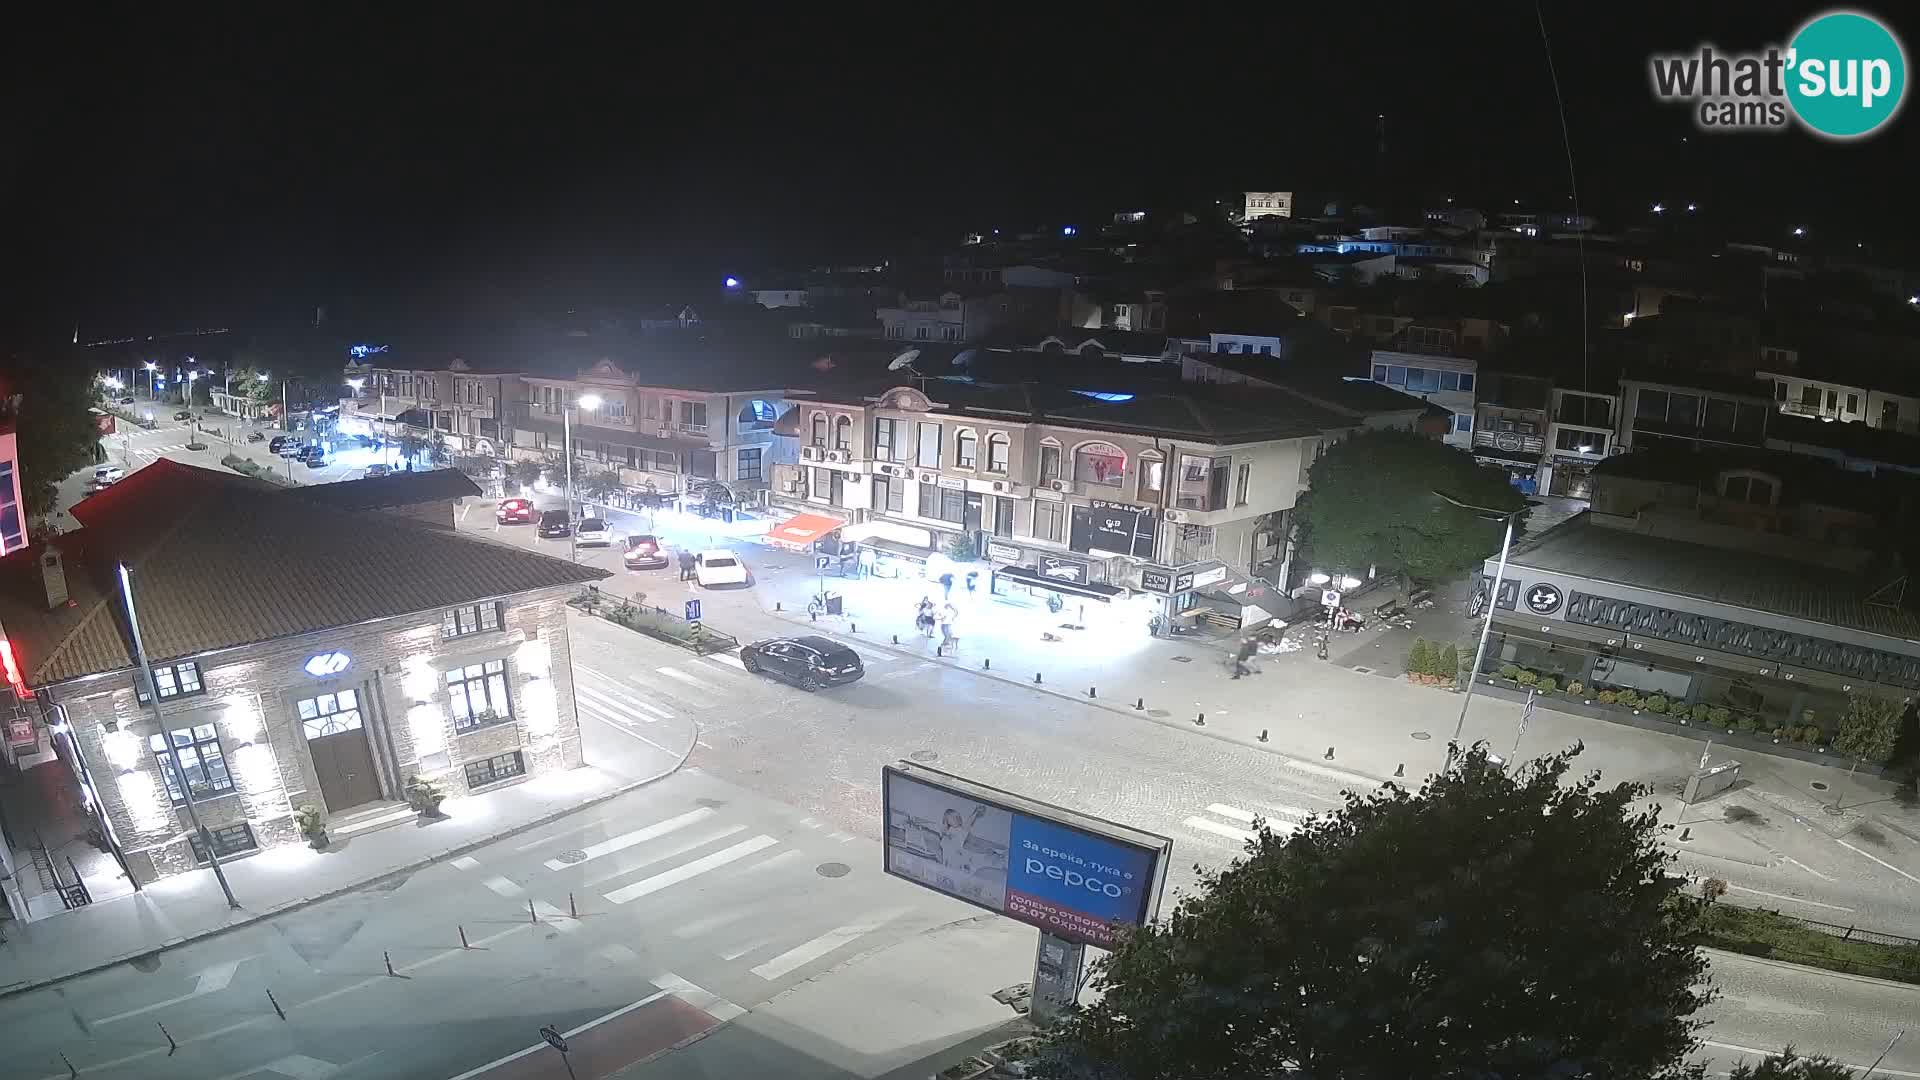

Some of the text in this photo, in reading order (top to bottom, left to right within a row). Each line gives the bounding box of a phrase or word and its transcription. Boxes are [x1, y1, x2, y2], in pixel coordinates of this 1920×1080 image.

[1022, 839, 1133, 880] За срека, тука е
[1025, 857, 1122, 898] pepco
[1010, 894, 1056, 914] ГОЛЕМО
[1010, 902, 1047, 919] 02.07
[1049, 915, 1096, 939] ОХРИД
